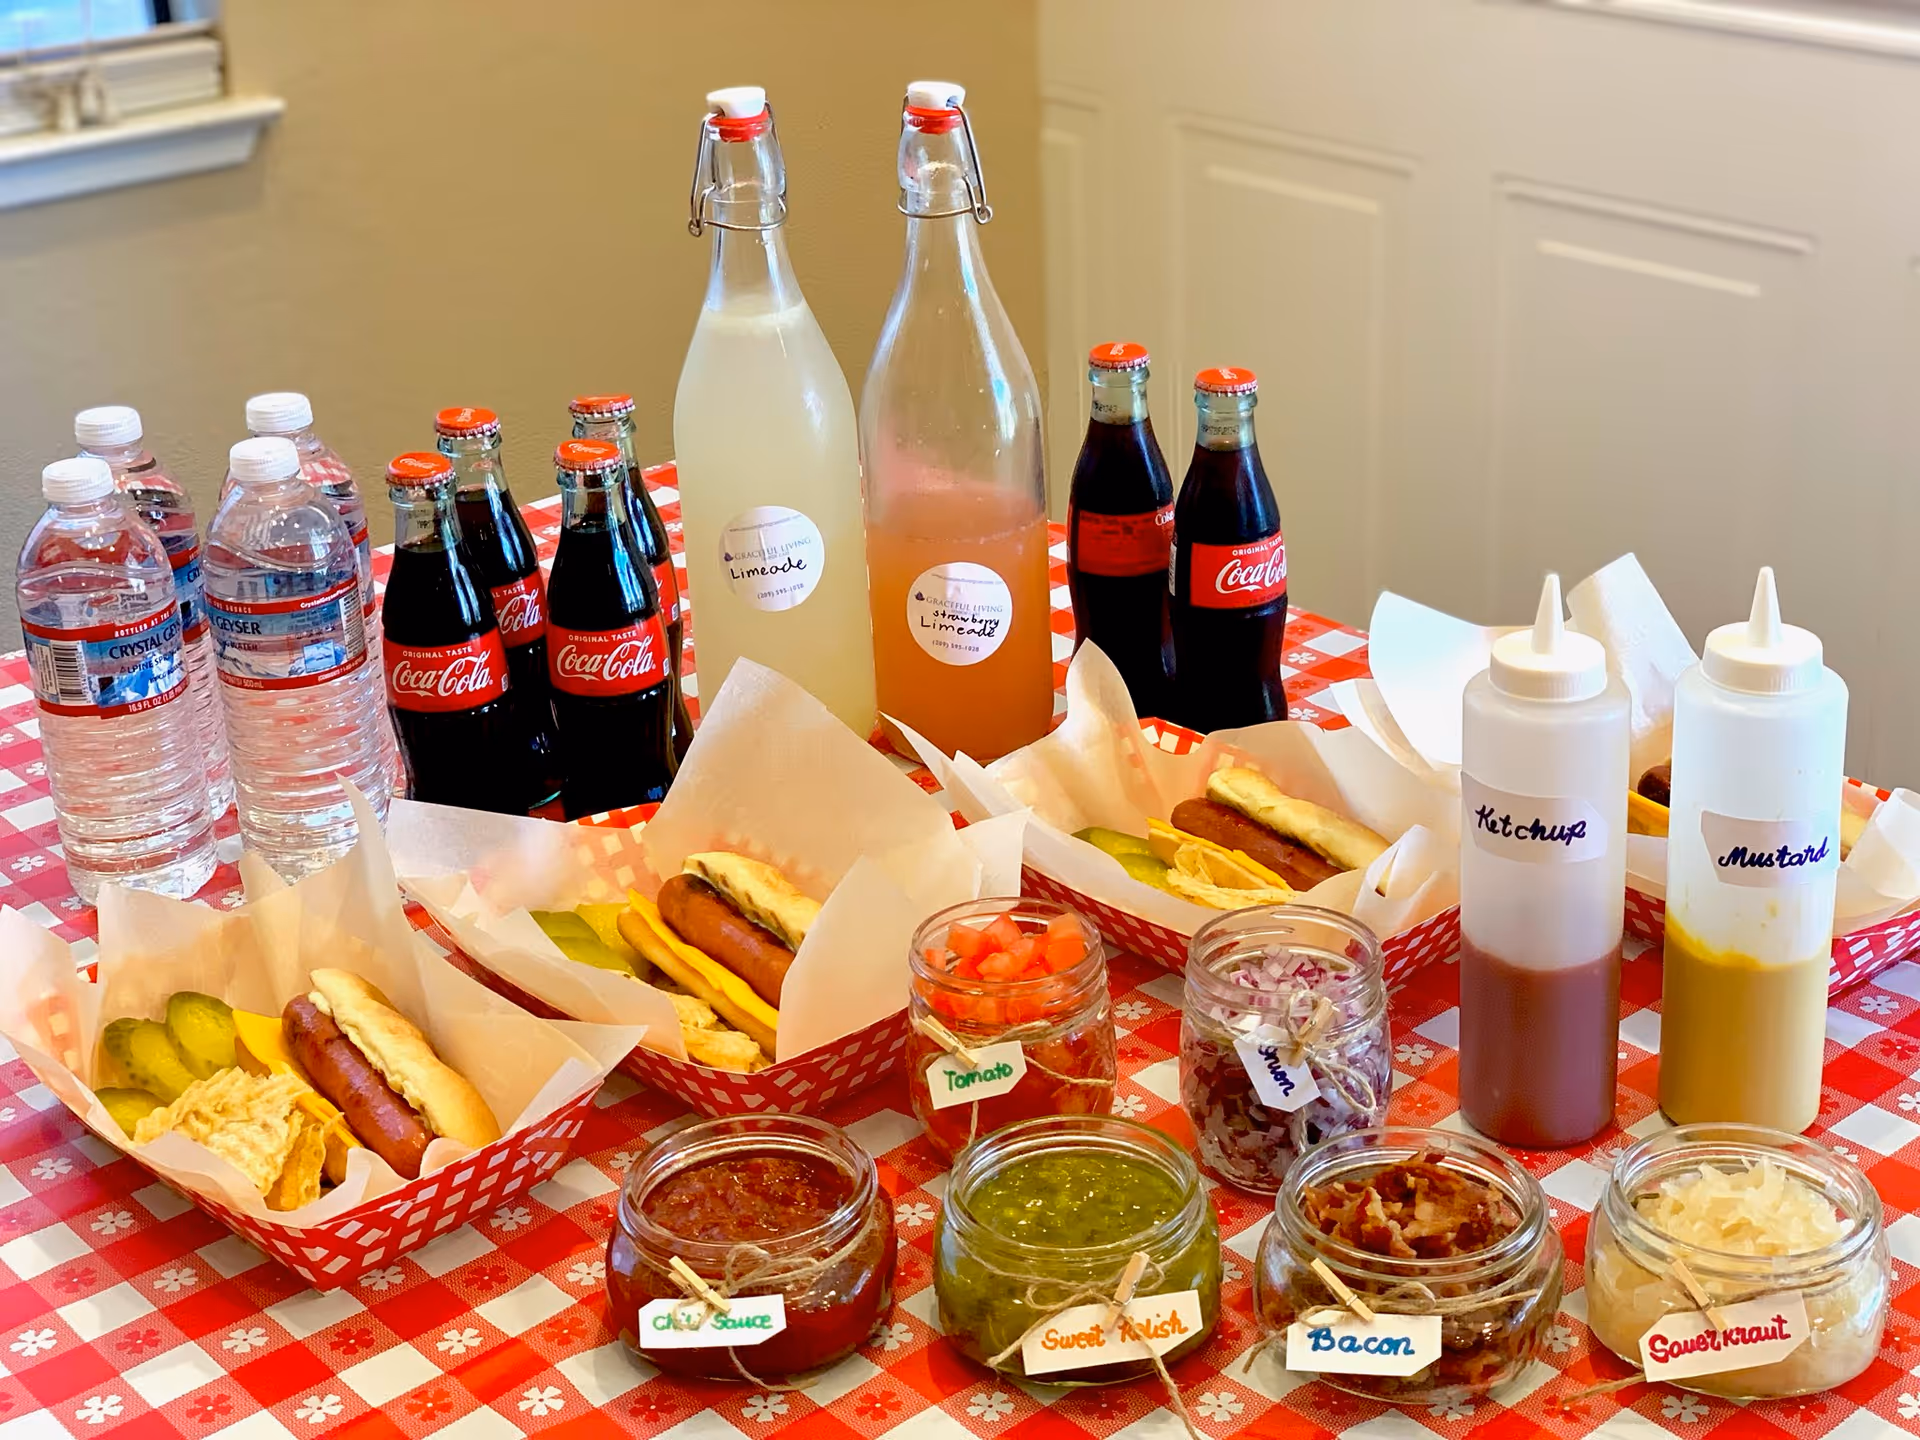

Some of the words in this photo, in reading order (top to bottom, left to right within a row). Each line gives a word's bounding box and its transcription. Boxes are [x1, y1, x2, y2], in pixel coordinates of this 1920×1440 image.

[781, 537, 811, 552] LIVING
[1232, 543, 1268, 556] ORIGINAL
[730, 556, 807, 579] Limeade
[503, 584, 525, 596] TASTE
[926, 596, 970, 611] GRACEFUL
[973, 604, 1003, 613] LIVING
[114, 623, 148, 638] BOTTLED
[150, 617, 159, 626] AT
[215, 615, 262, 635] GEYSER
[920, 616, 995, 638] Limeade
[109, 633, 163, 659] CRYSTAL
[568, 634, 608, 643] ORIGINAL
[611, 630, 637, 641] TASTE
[402, 650, 444, 659] ORIGINAL
[446, 645, 473, 655] TASTE
[557, 635, 656, 682] Coca-Cola
[120, 660, 154, 674] ALPINE
[392, 649, 493, 697] Coca-Cola
[128, 703, 143, 713] 16.9
[143, 700, 152, 709] FL
[152, 695, 163, 706] OZ
[1474, 804, 1588, 846] Ketchup
[1717, 835, 1830, 869] Mustard
[943, 1062, 1014, 1092] Tomato
[710, 1312, 774, 1331] Sauce
[1041, 1323, 1106, 1351] Sweet
[1306, 1326, 1416, 1356] Bacon
